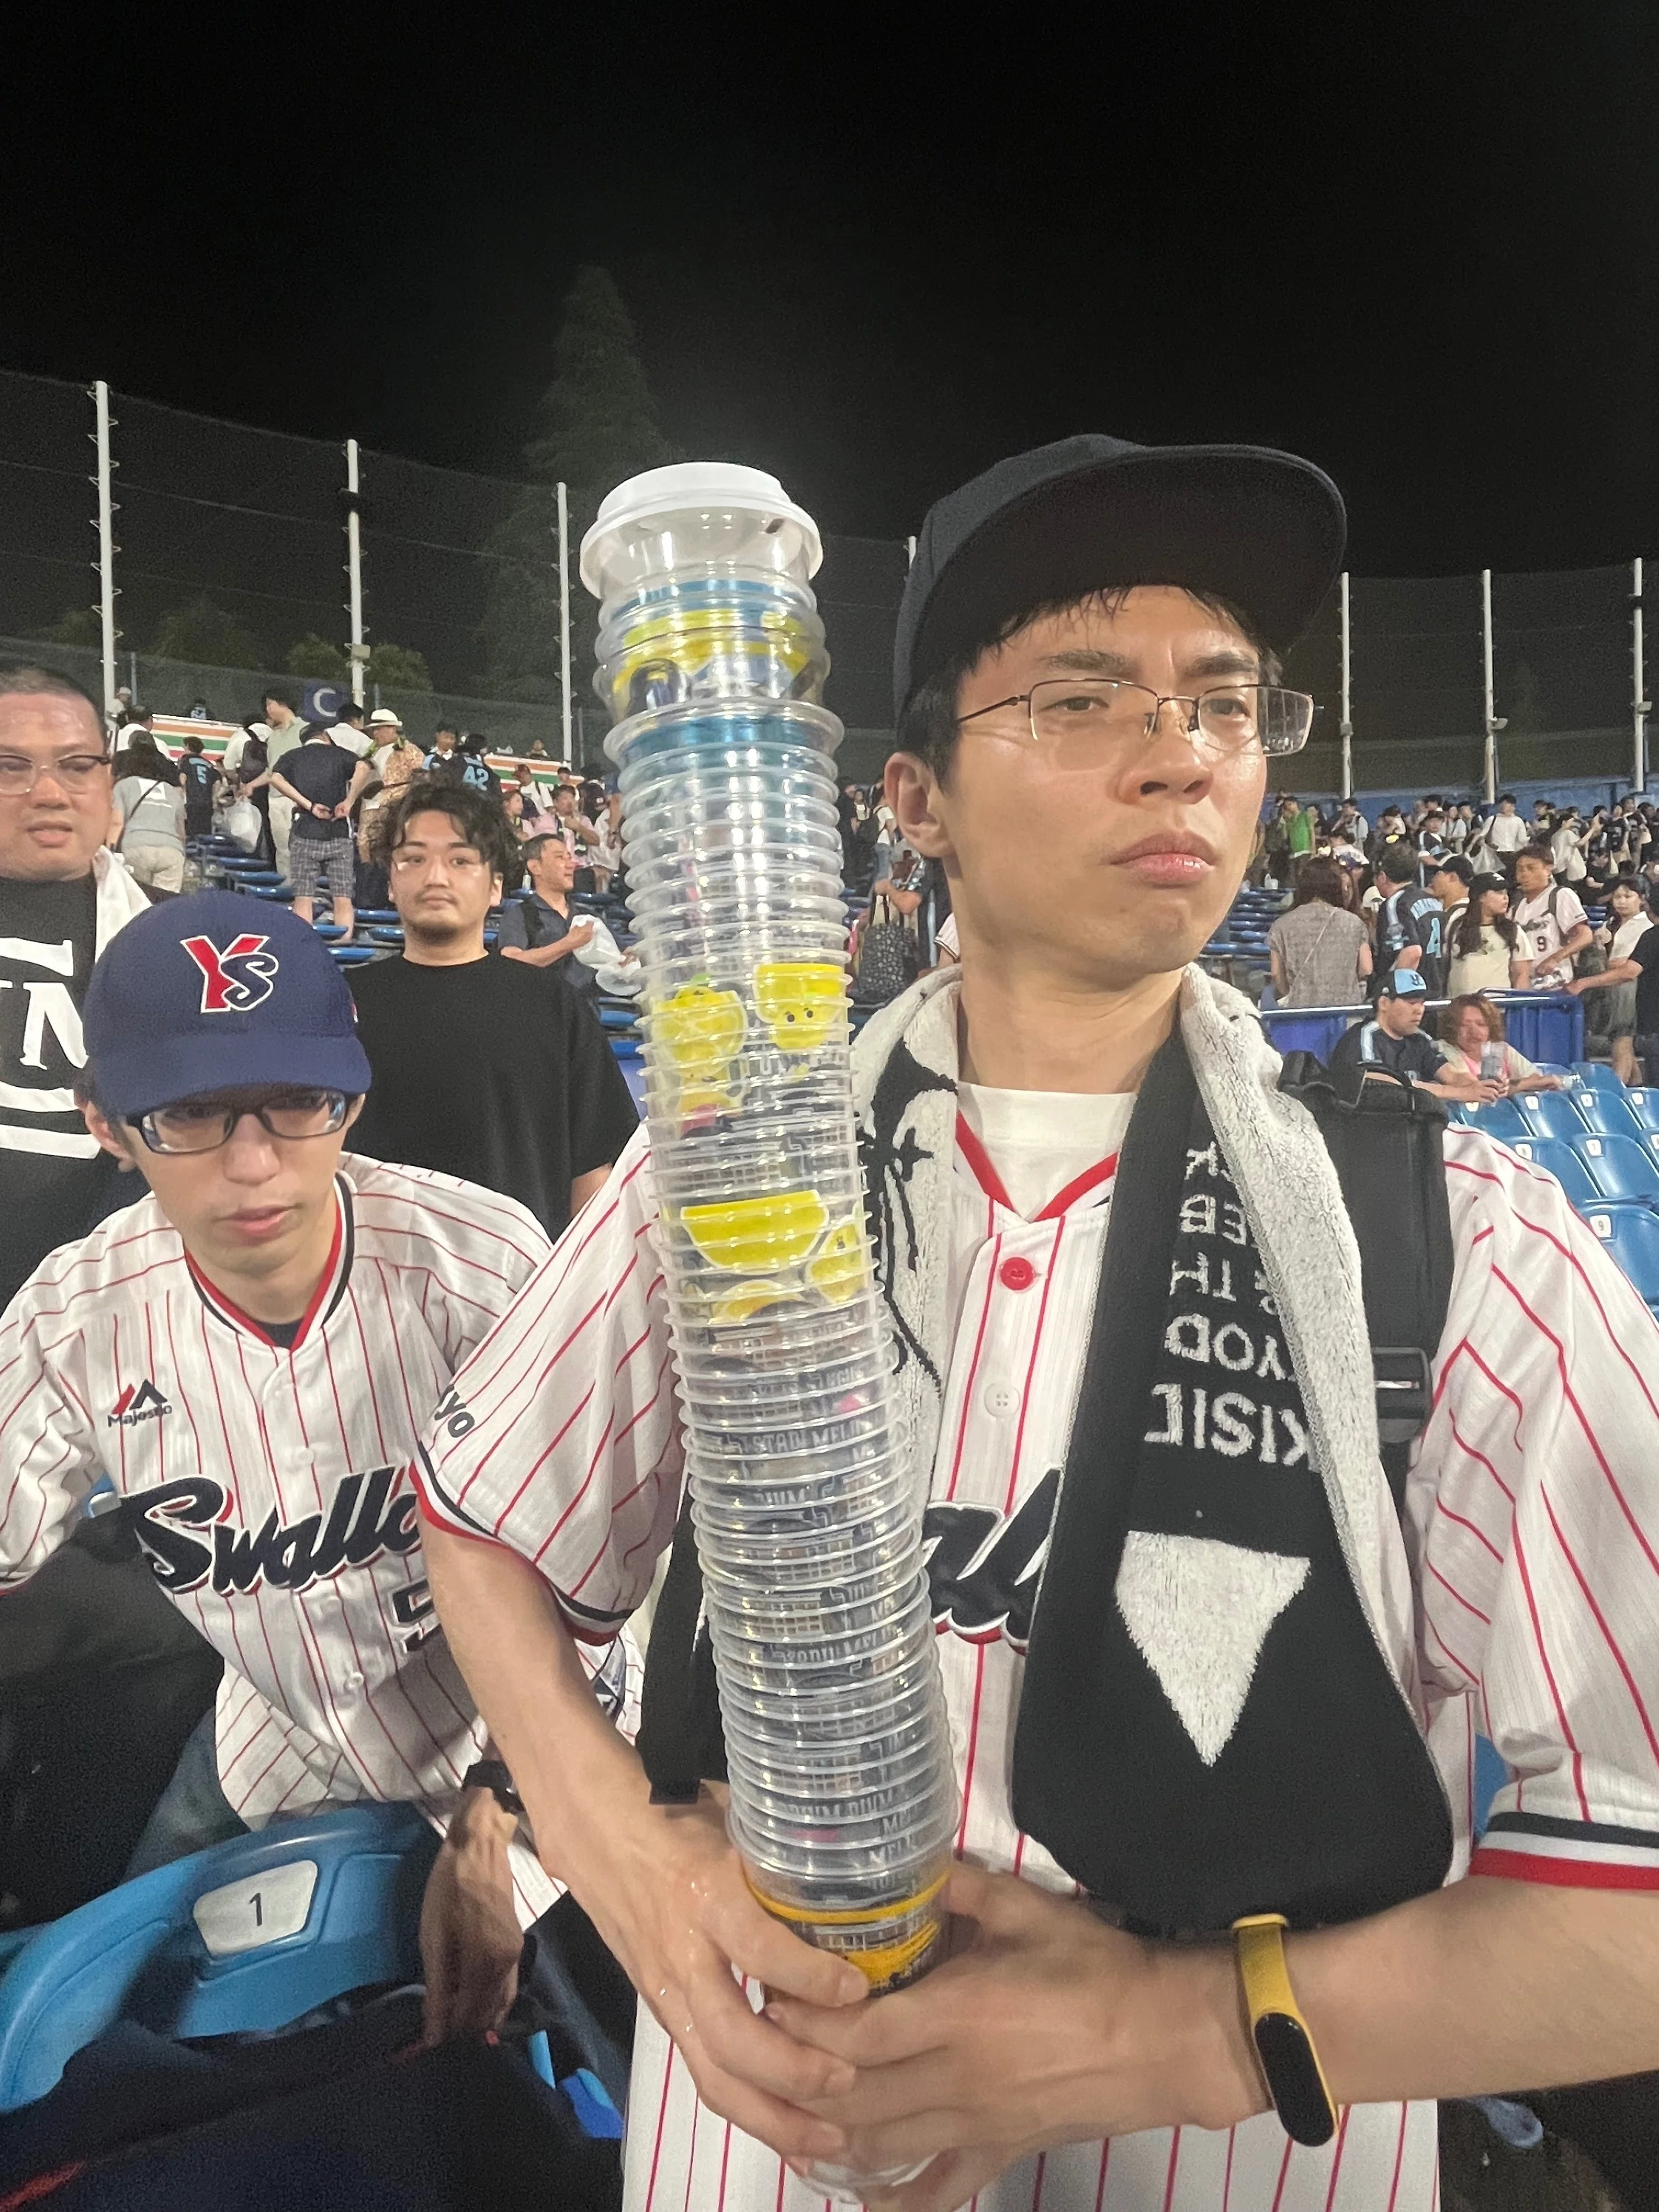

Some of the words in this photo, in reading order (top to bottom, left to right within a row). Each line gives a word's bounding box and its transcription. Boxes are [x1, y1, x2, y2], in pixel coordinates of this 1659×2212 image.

[1537, 936, 1547, 952] 9
[1598, 1220, 1605, 1231] 9
[249, 1892, 263, 1927] 1
